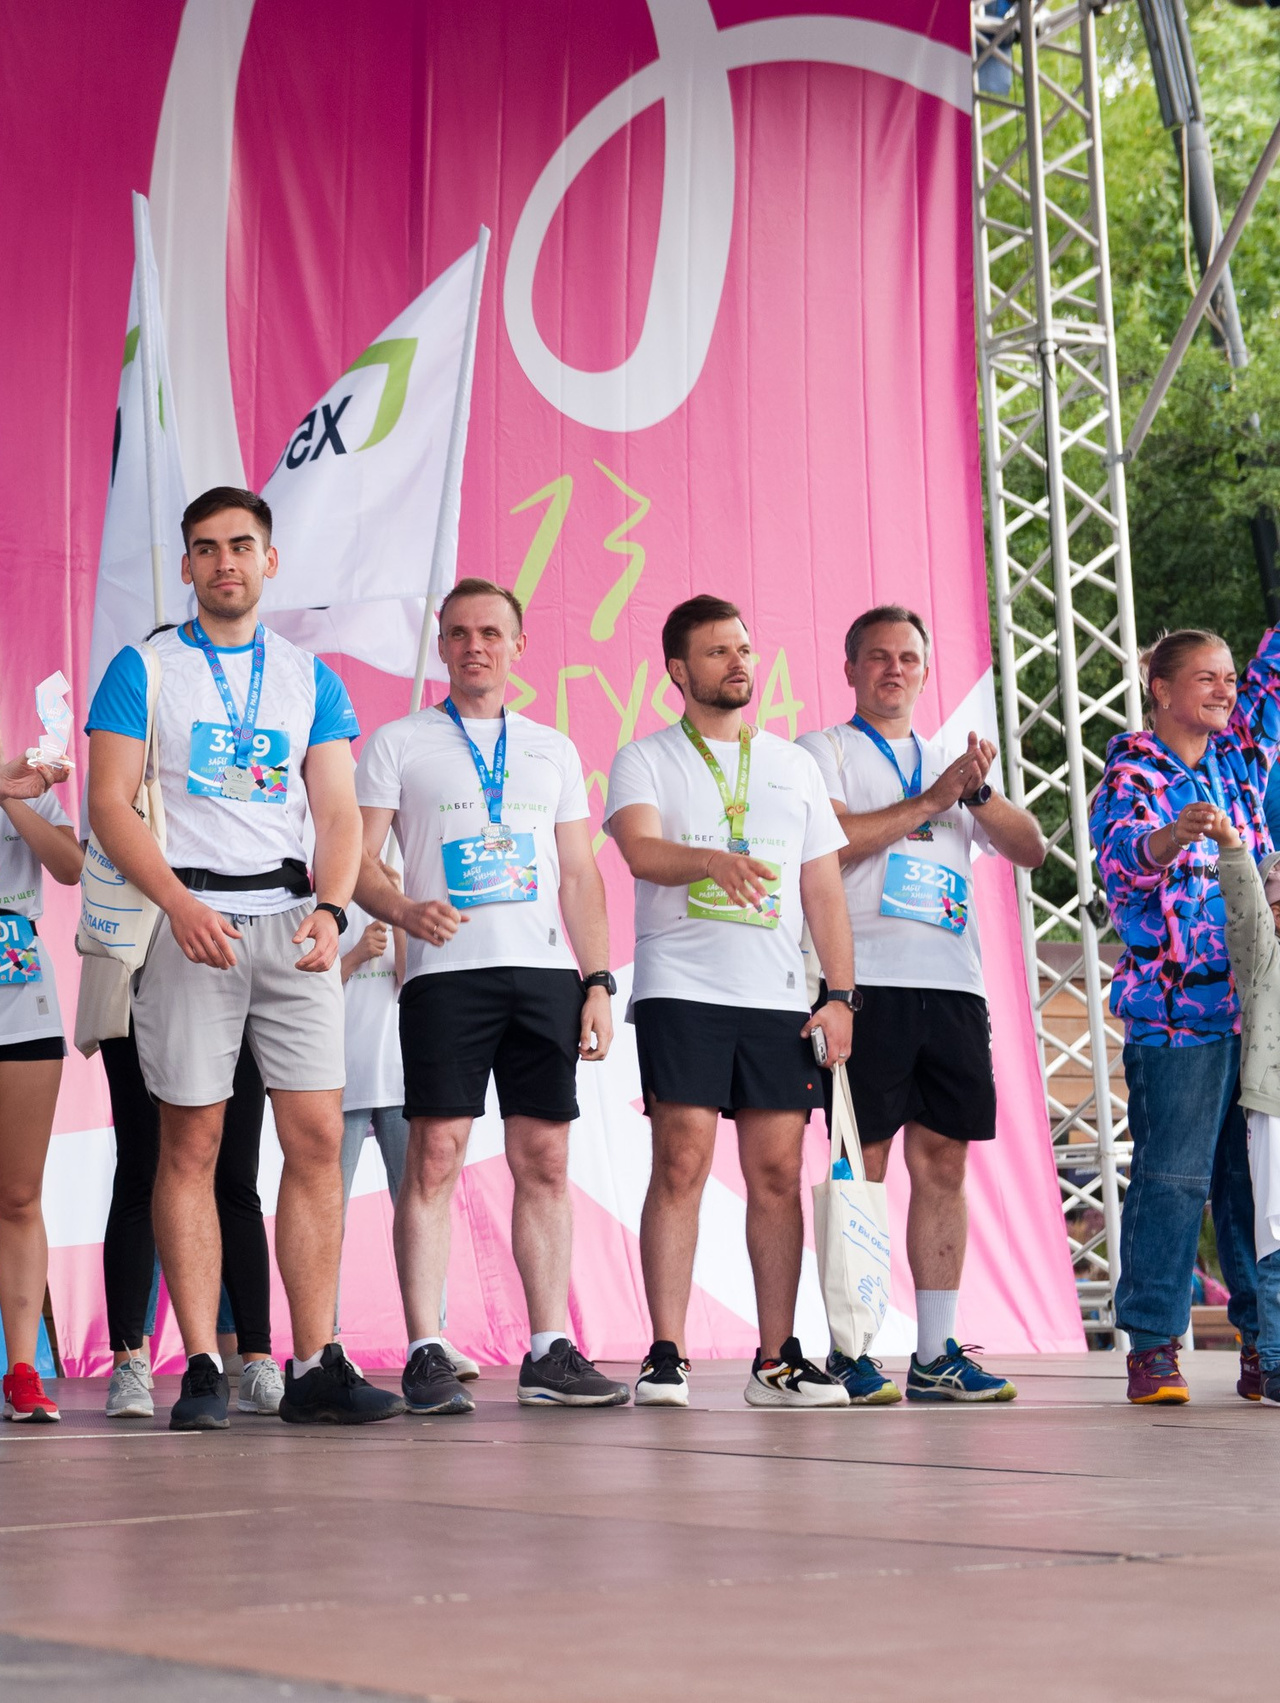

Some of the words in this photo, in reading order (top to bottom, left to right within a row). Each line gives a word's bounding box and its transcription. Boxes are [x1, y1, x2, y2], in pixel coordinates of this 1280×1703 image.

[510, 458, 650, 641] 13
[209, 728, 271, 757] 329
[439, 802, 474, 812] ЗАБЕГ
[681, 834, 714, 842] ЗАБЕГ
[746, 838, 787, 848] УДУЩЕЕ
[904, 860, 956, 893] 3221
[87, 914, 120, 934] ПАКЕТ
